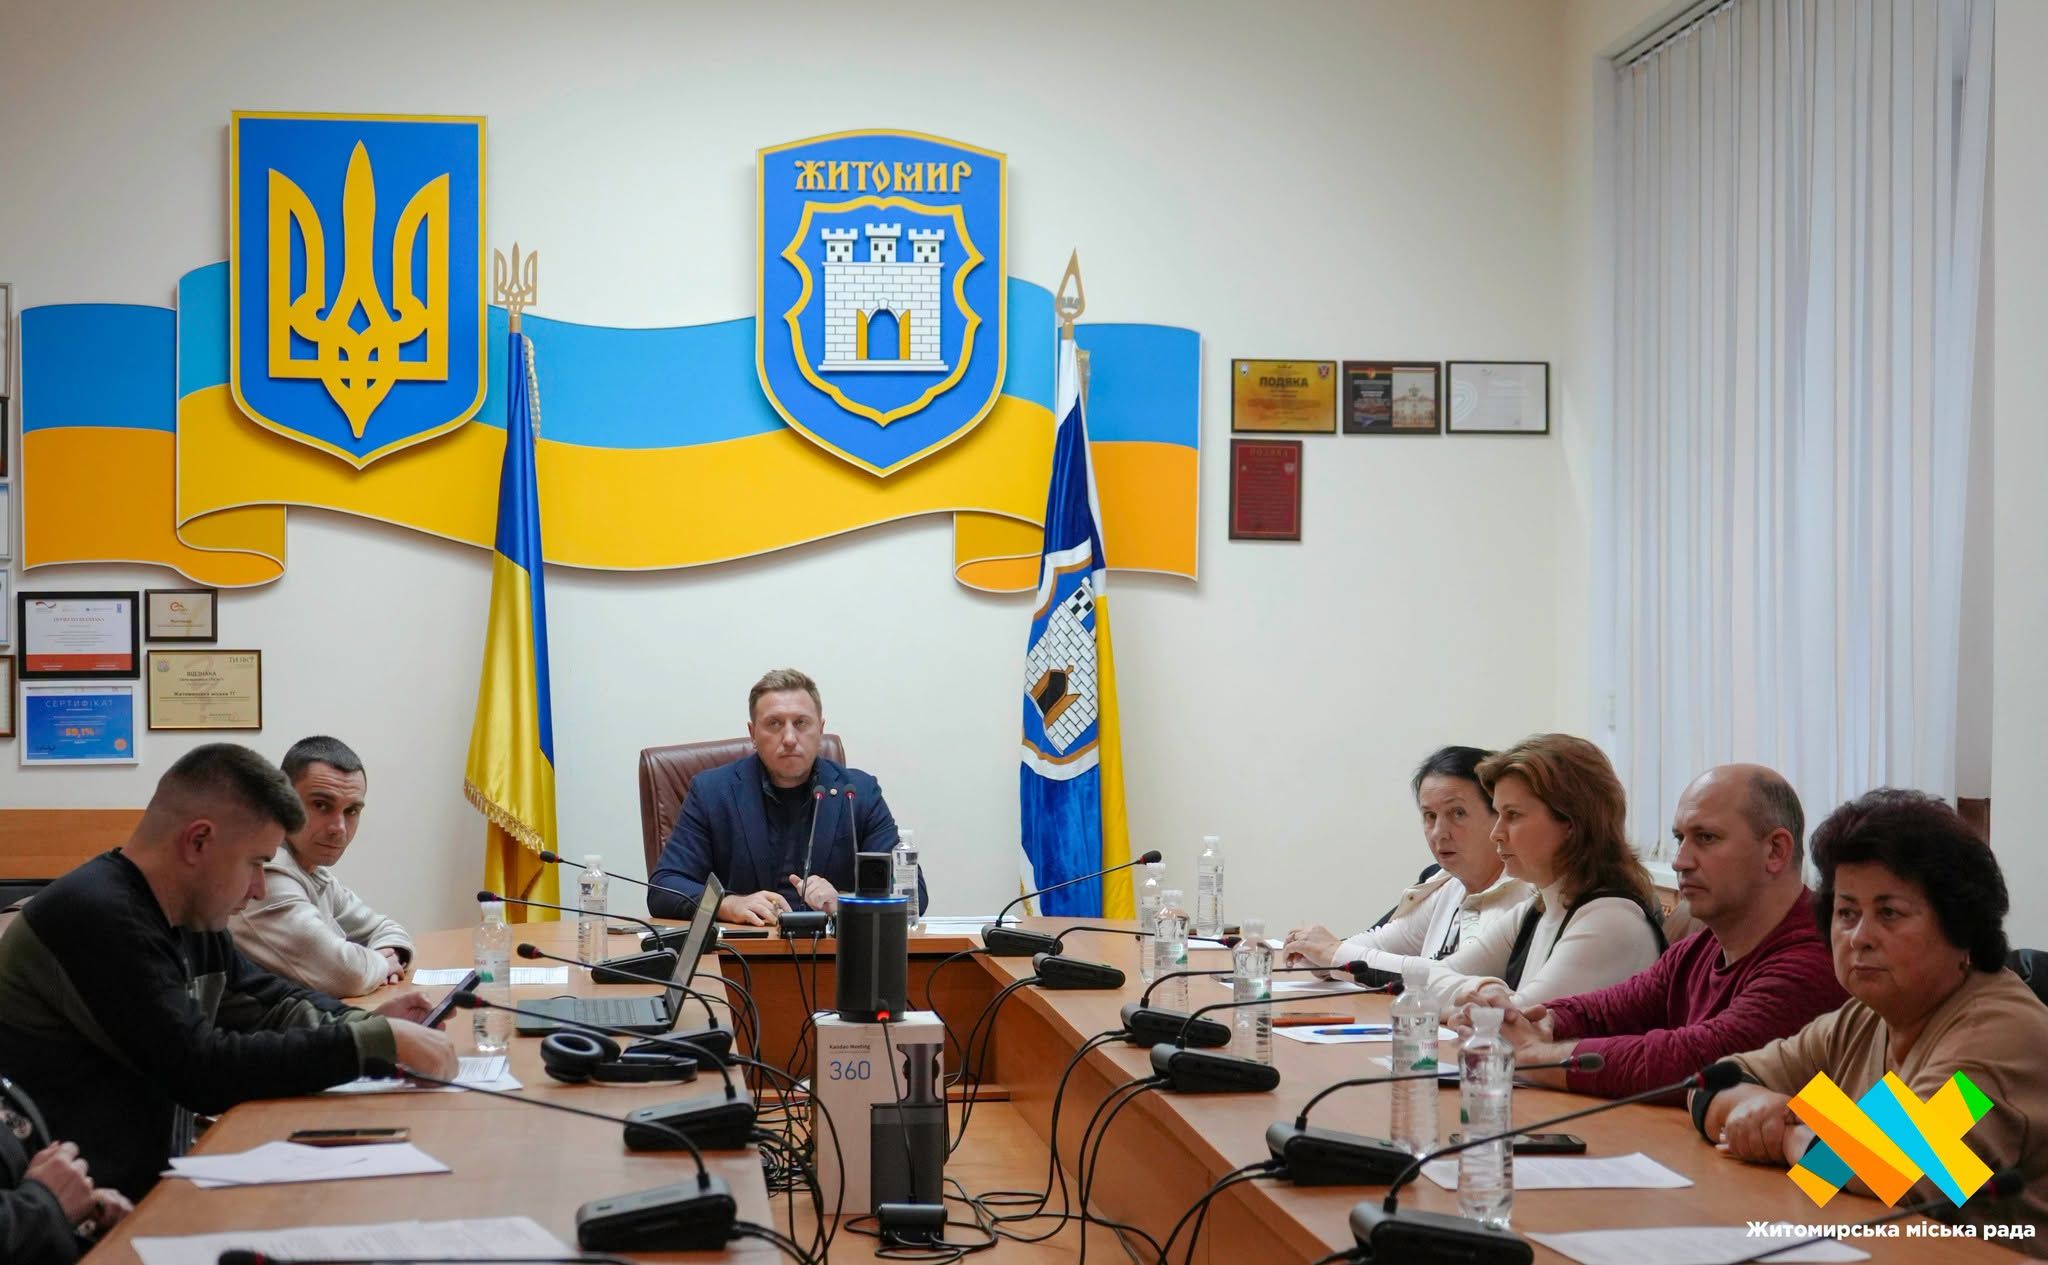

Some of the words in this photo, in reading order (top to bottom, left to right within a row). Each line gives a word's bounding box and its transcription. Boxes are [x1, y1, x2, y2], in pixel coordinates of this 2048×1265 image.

[793, 160, 972, 193] ЖИТОМИР
[1260, 376, 1309, 388] ПОДЯКА
[45, 699, 113, 709] СЕРТИФІКАТ
[830, 1060, 871, 1081] 360
